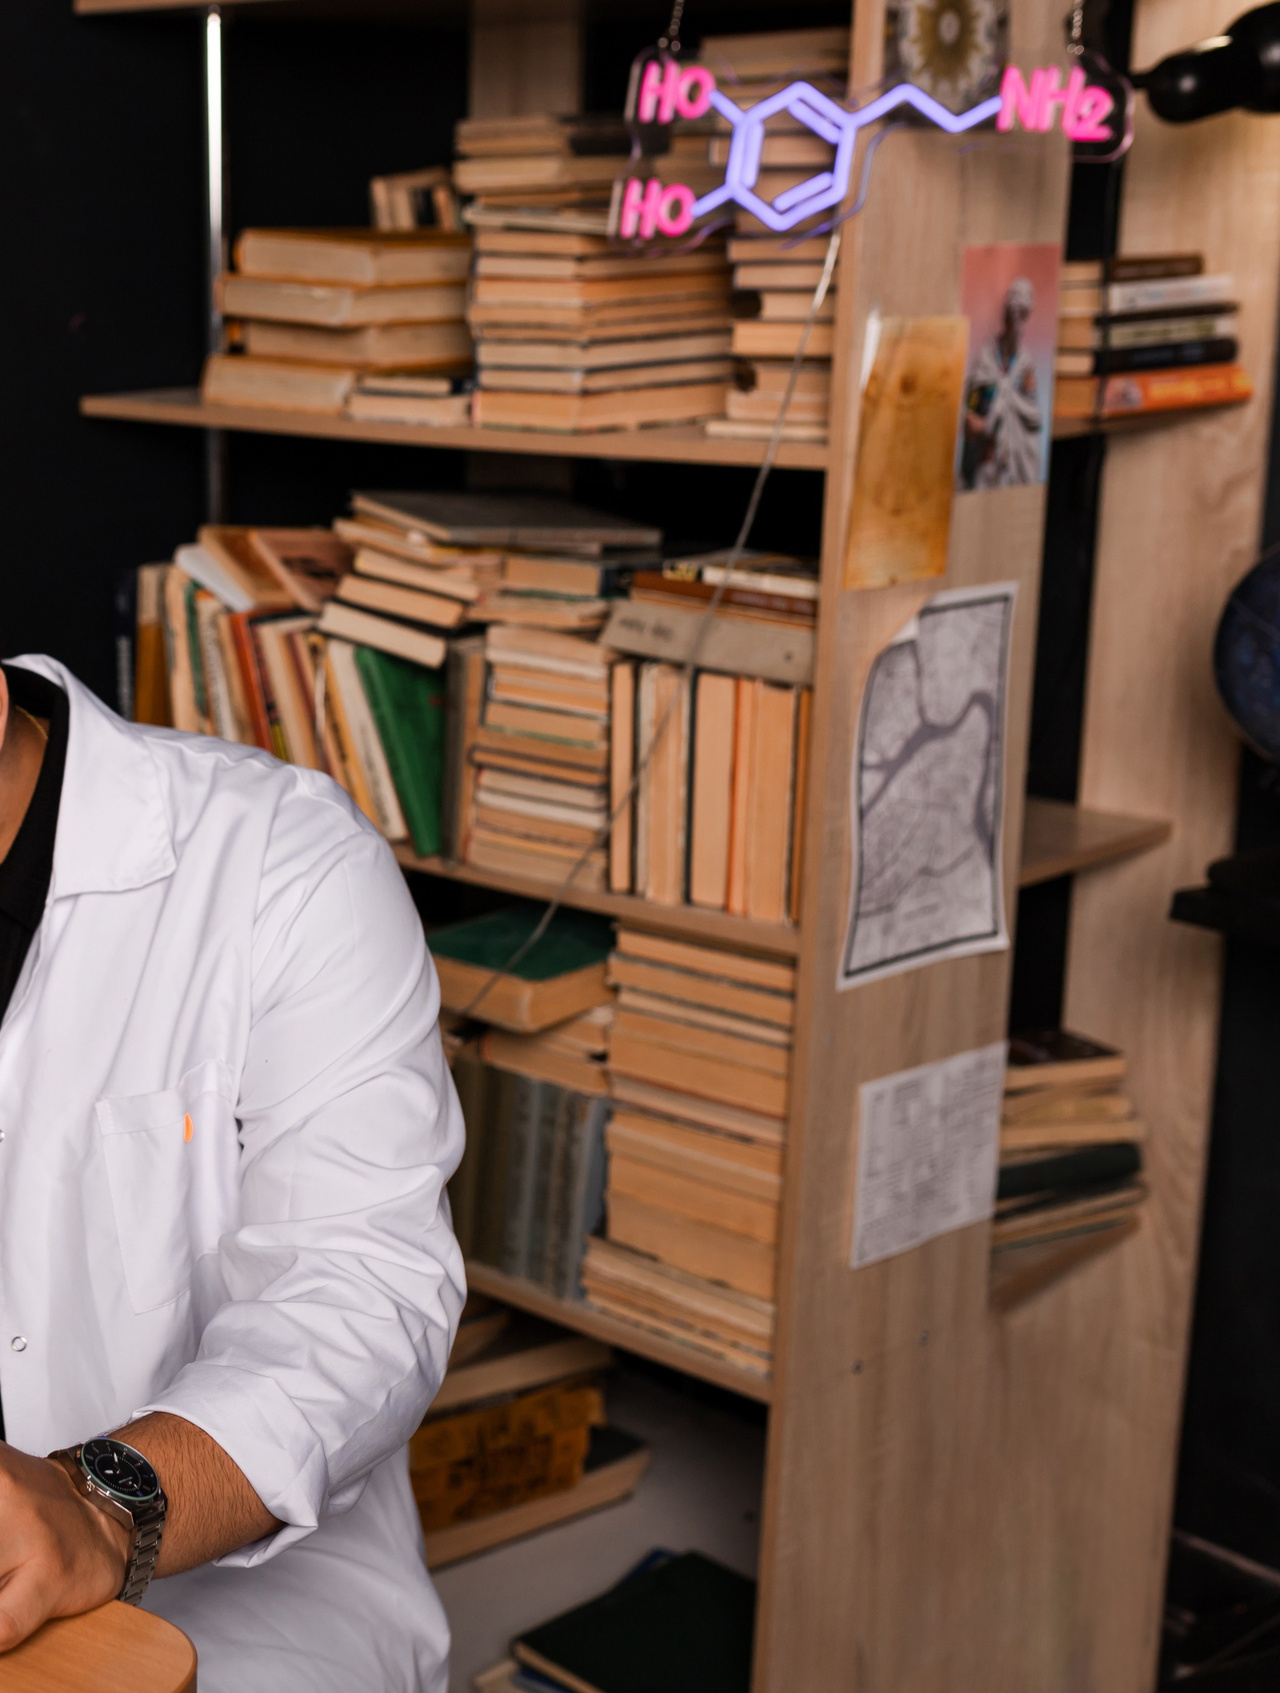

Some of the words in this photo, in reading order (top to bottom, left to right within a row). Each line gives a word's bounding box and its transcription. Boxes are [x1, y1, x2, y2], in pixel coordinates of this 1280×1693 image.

[638, 59, 716, 124] HO
[995, 64, 1114, 143] NH2
[620, 177, 697, 239] HO
